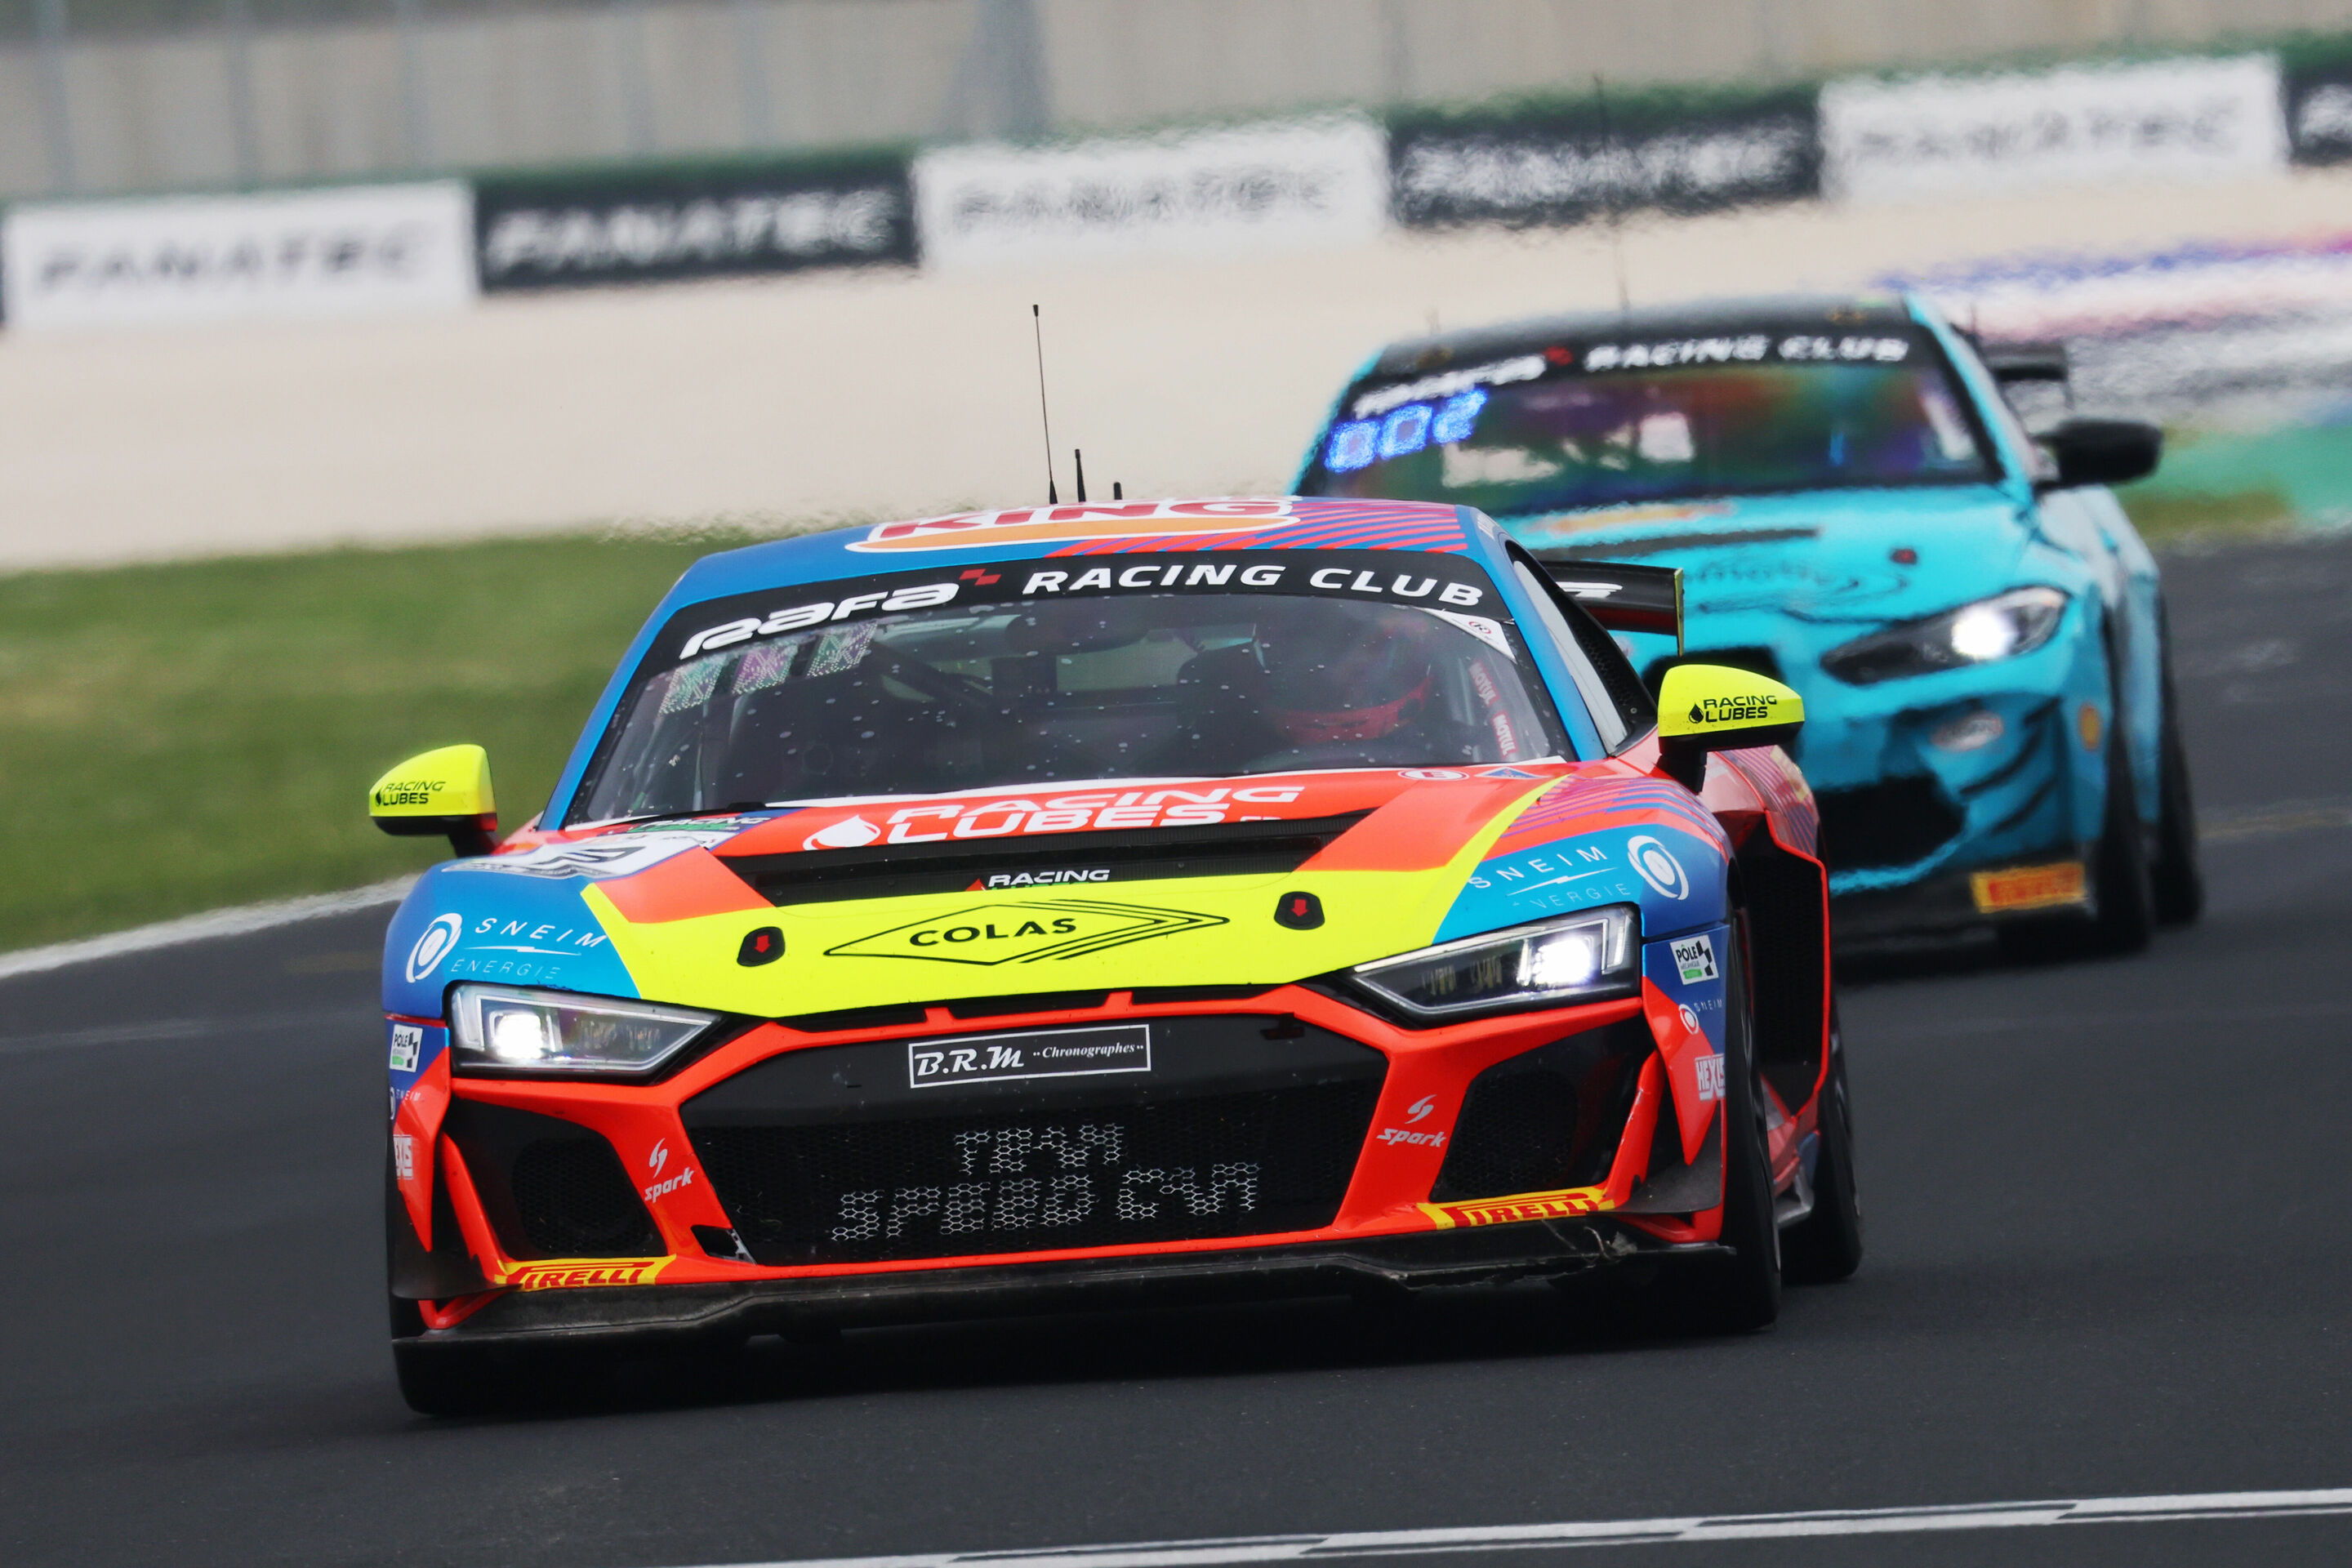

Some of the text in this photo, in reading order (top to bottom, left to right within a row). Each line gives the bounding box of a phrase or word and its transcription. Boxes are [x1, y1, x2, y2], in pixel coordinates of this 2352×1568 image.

[1584, 333, 1909, 372] RACING CLUB
[878, 499, 1283, 540] KING
[1022, 564, 1286, 595] RACING
[1310, 567, 1483, 607] CLUB
[1704, 696, 1777, 709] RACING
[1705, 706, 1768, 723] LUBES
[1492, 714, 1517, 756] MOTUL
[383, 792, 430, 806] LUBES
[385, 781, 446, 792] RACING
[886, 786, 1306, 824] RACING
[886, 804, 1232, 845] LUBES
[988, 869, 1111, 888] RACING
[1468, 846, 1608, 889] SNEIM
[474, 916, 609, 948] SNEIM
[909, 917, 1077, 947] COLAS
[451, 958, 562, 979] ENERGIE
[1377, 1128, 1448, 1148] spark
[644, 1166, 695, 1204] spark
[831, 1174, 1099, 1241] SPEED
[1440, 1192, 1599, 1228] PIRELLI
[506, 1261, 655, 1290] PIRELLI
